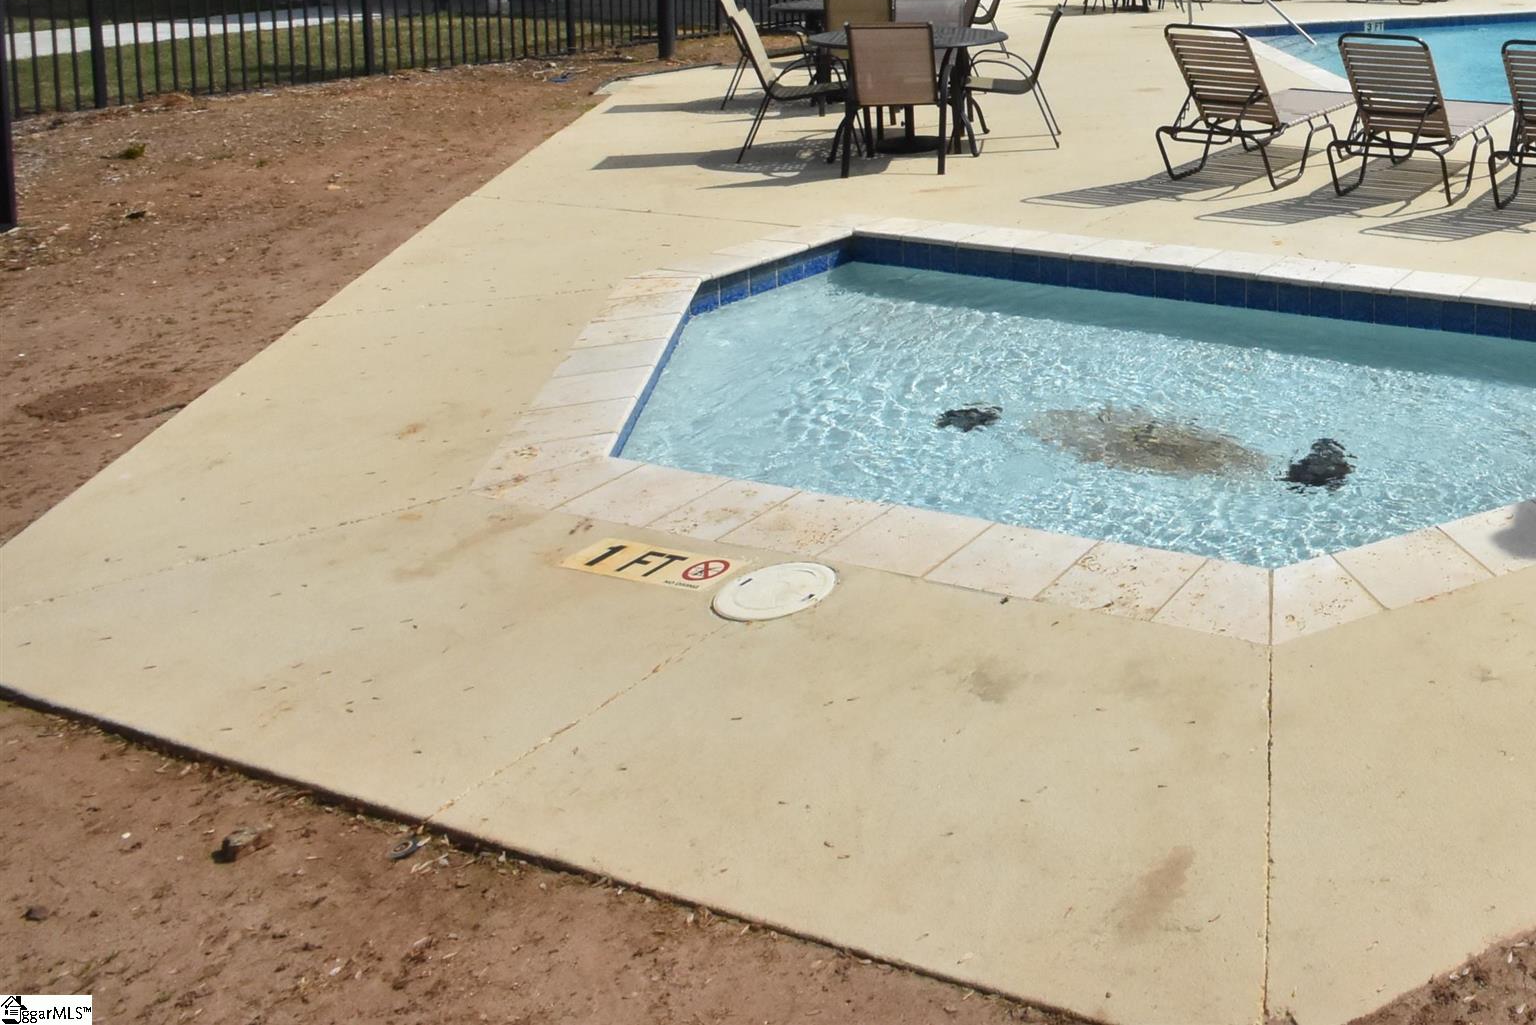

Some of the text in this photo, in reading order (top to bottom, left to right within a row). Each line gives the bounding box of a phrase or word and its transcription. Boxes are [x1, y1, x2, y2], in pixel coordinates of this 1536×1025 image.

[1374, 21, 1384, 32] FT
[584, 544, 689, 577] 1 FT
